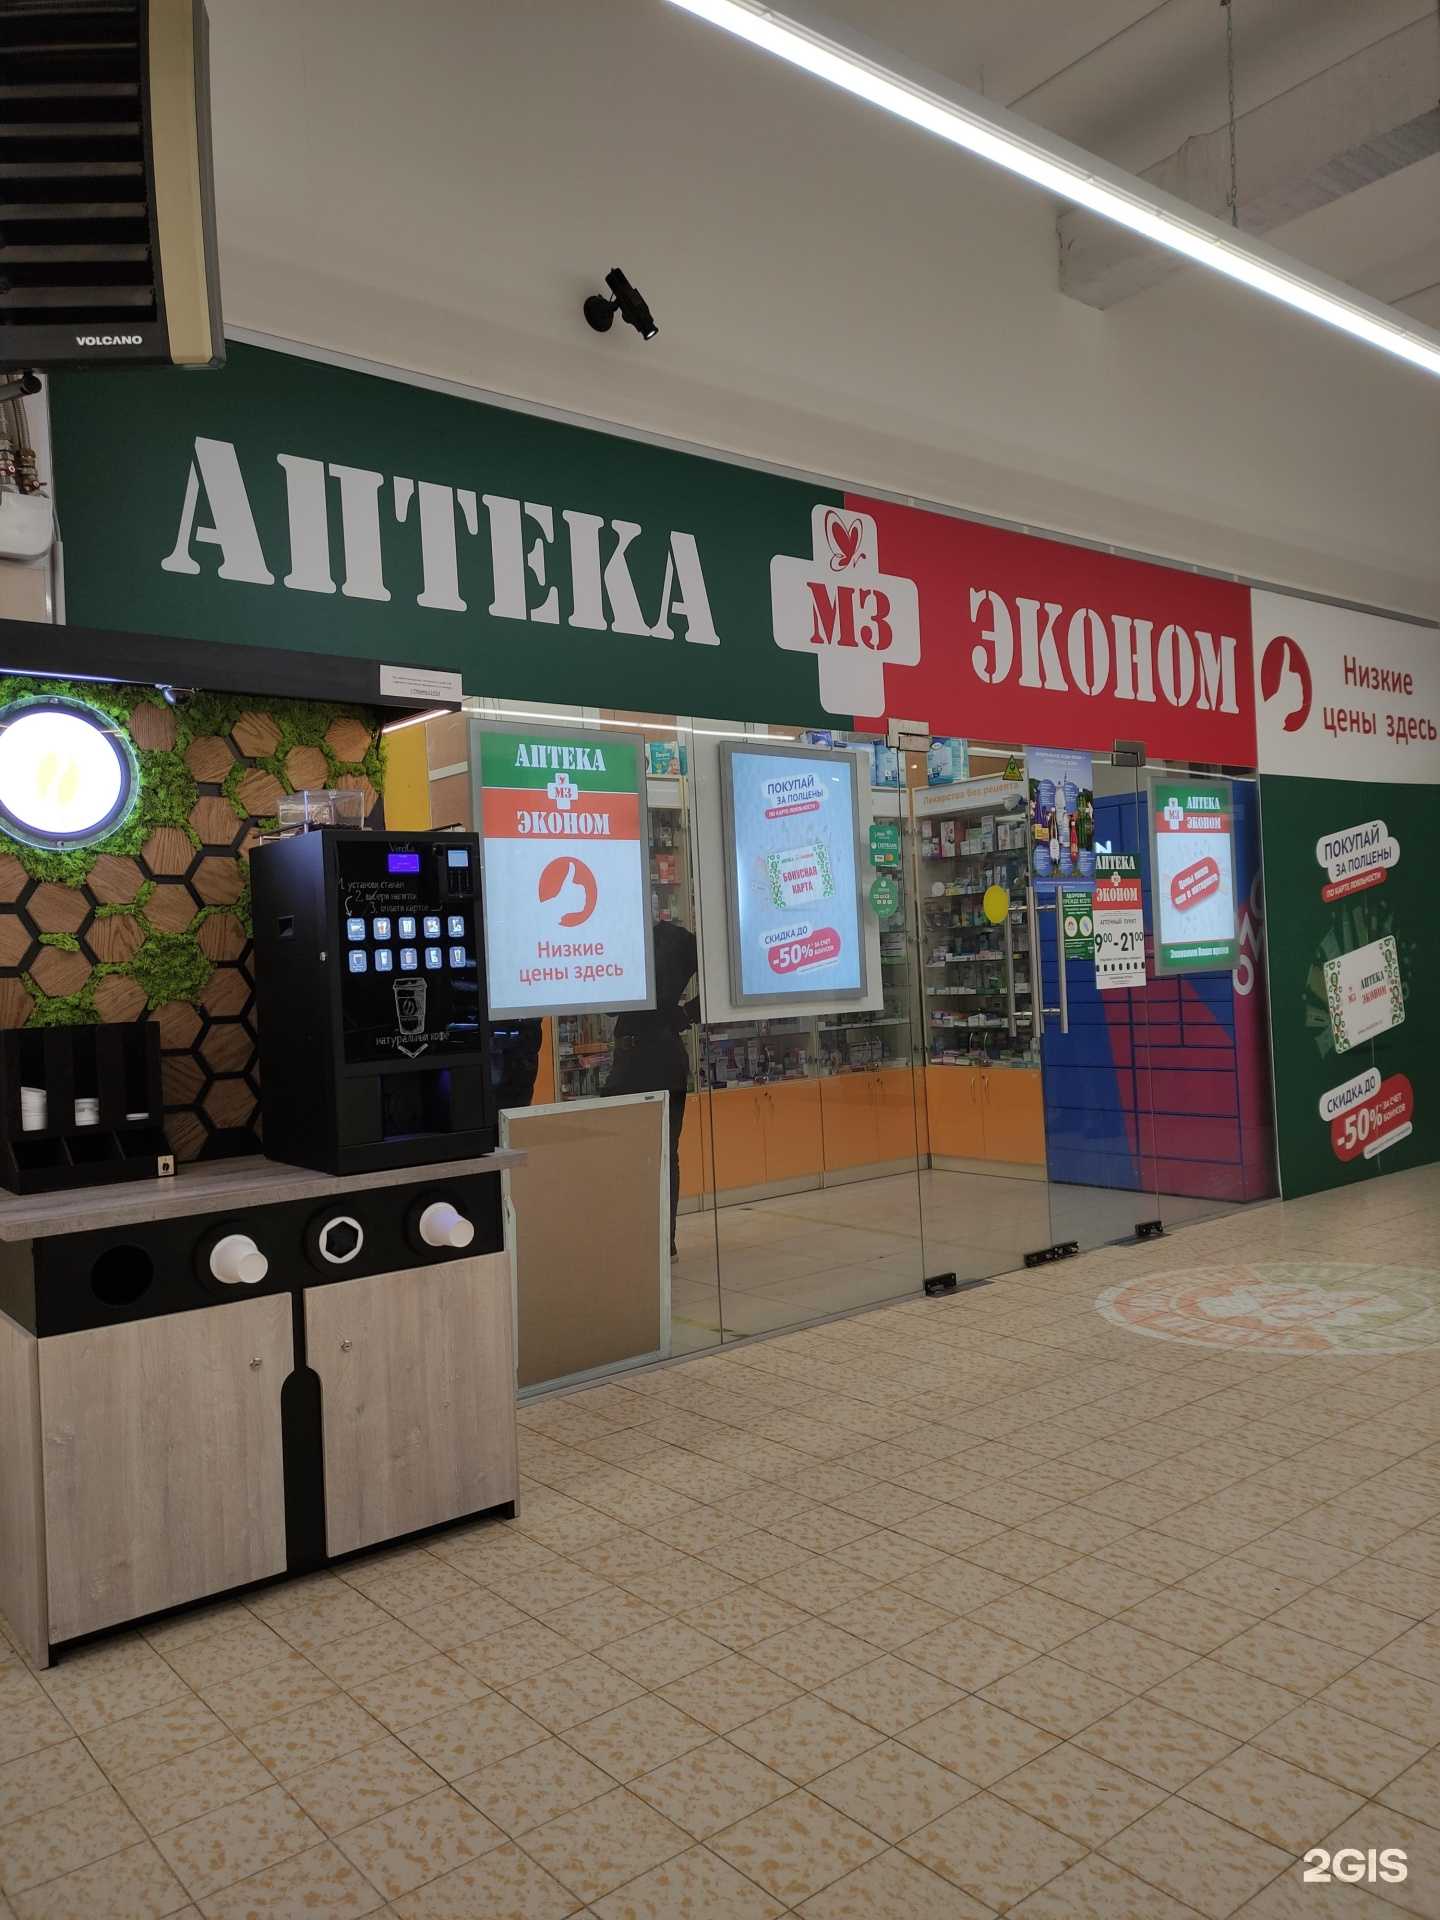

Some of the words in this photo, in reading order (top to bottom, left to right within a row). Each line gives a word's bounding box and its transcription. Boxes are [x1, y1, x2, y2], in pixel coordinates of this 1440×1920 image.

[75, 335, 143, 346] VOLCANO
[161, 436, 721, 646] АПТЕКА
[969, 586, 1240, 715] ЭКОНОМ
[1343, 654, 1413, 695] Низкие
[1323, 706, 1377, 738] цены
[1386, 714, 1438, 745] здесь
[514, 743, 606, 771] АПТЕКА
[767, 774, 815, 795] ПОКУПАЙ
[777, 796, 786, 805] ЗА
[787, 788, 823, 803] ПОЛЦЕНЫ
[1185, 796, 1221, 810] АПТЕКА
[516, 810, 611, 835] ЭКОНОМ
[1186, 816, 1222, 829] ЭКОНОМ
[1324, 824, 1380, 860] ПОКУПАЙ
[1095, 855, 1136, 870] АПТЕКА
[1335, 863, 1347, 877] ЗА
[1348, 846, 1392, 873] ПОЛЦЕНЫ
[782, 866, 818, 882] БОНУСНАЯ
[792, 881, 814, 895] КАРТА
[1096, 887, 1138, 902] ЭКОНОМ
[764, 930, 796, 945] СКИДКА
[797, 925, 808, 937] ДО
[537, 940, 605, 959] Низкие
[519, 966, 569, 986] цены
[574, 963, 624, 982] здесь
[1327, 1083, 1363, 1113] СКИДКА
[1364, 1075, 1377, 1093] ДО
